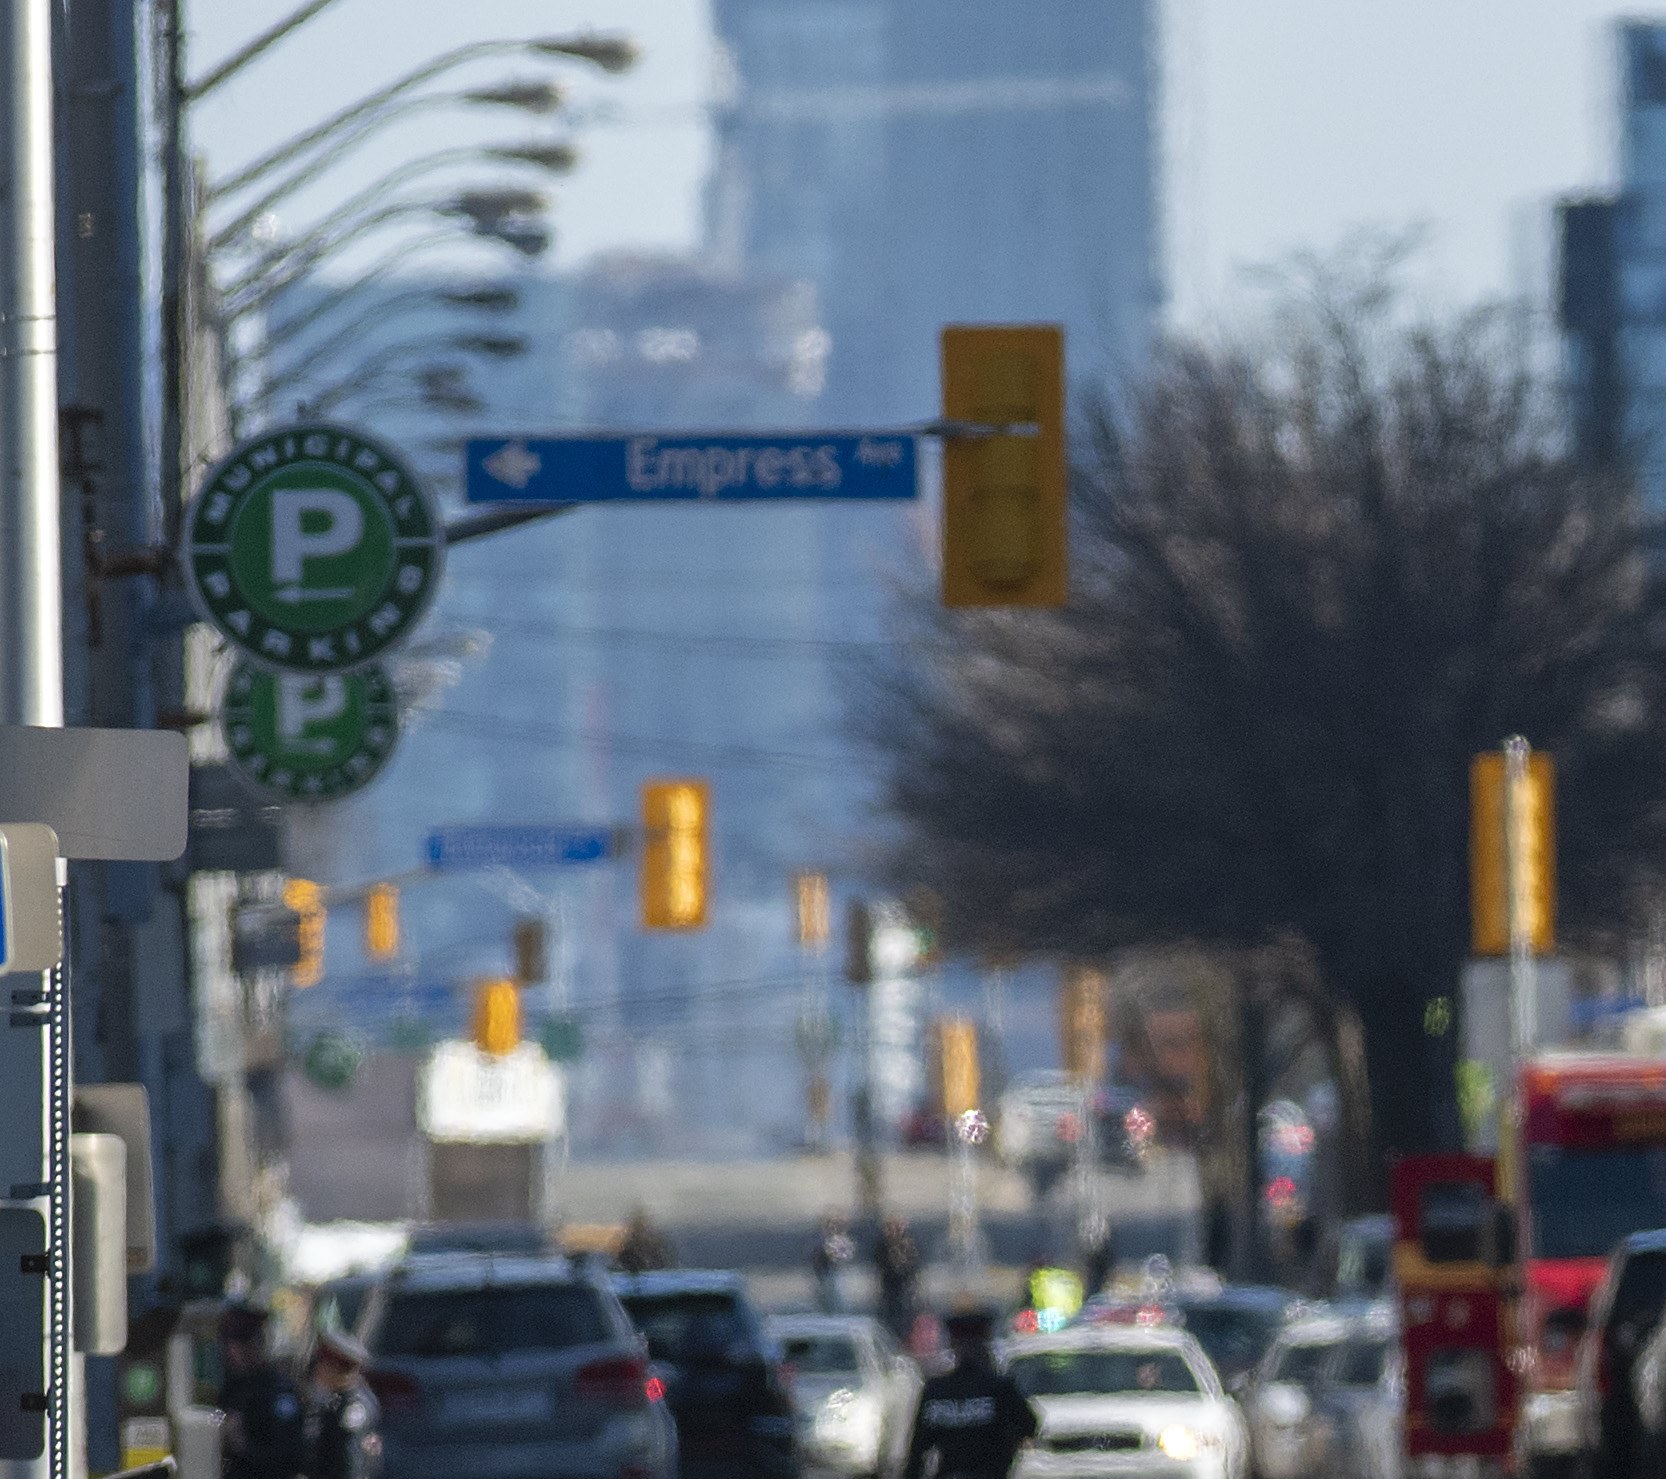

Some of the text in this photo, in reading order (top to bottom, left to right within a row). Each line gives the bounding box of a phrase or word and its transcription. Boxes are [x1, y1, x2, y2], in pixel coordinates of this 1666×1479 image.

[203, 433, 416, 525] MUNICIPAL
[626, 437, 842, 499] Empress
[271, 487, 363, 583] P
[203, 562, 424, 662] PARKING
